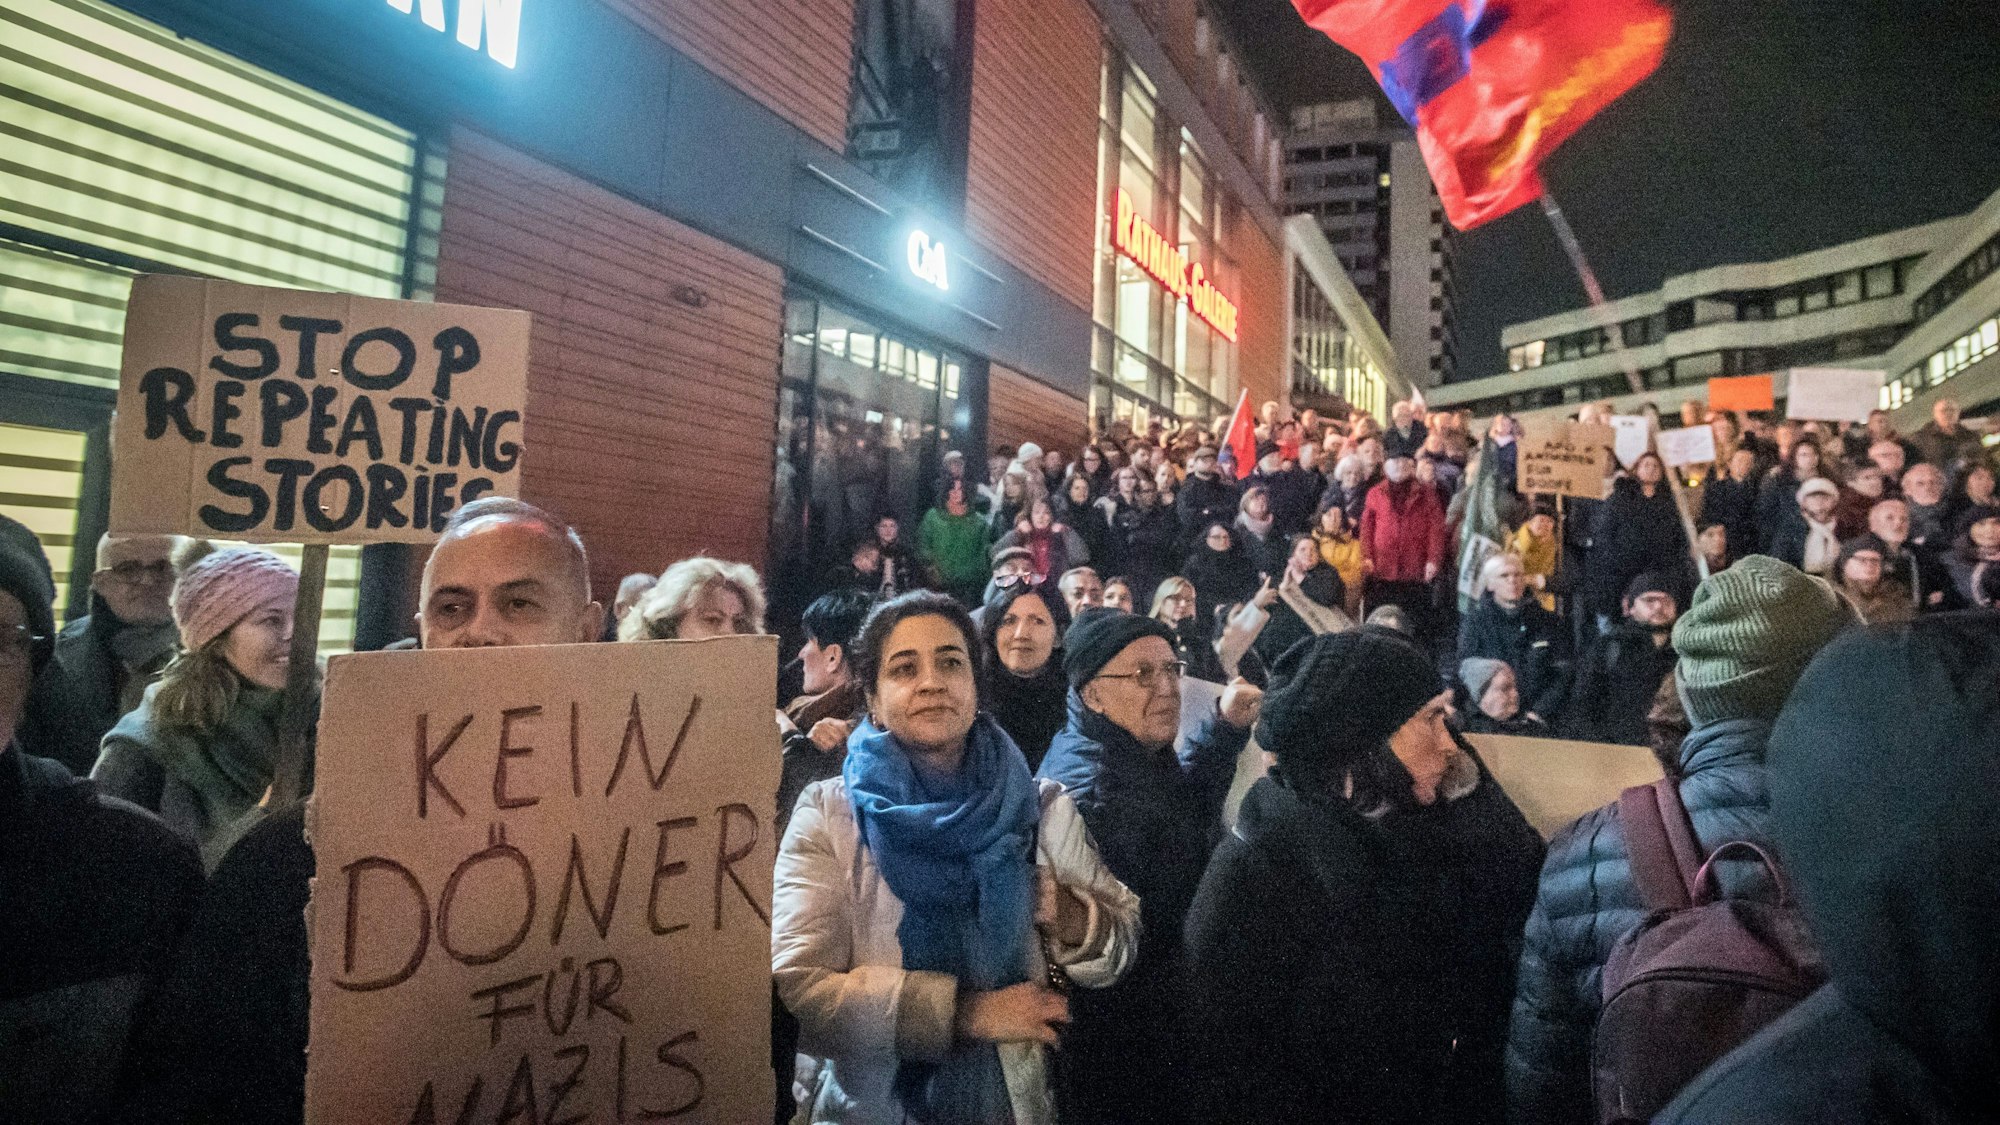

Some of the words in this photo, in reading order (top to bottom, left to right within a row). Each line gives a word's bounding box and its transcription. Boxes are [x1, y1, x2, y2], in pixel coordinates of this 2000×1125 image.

[209, 312, 481, 400] STOP
[139, 366, 520, 473] REPEATING
[414, 692, 701, 819] KEIN
[332, 803, 771, 992] DÖNER
[471, 956, 633, 1048] FÜR
